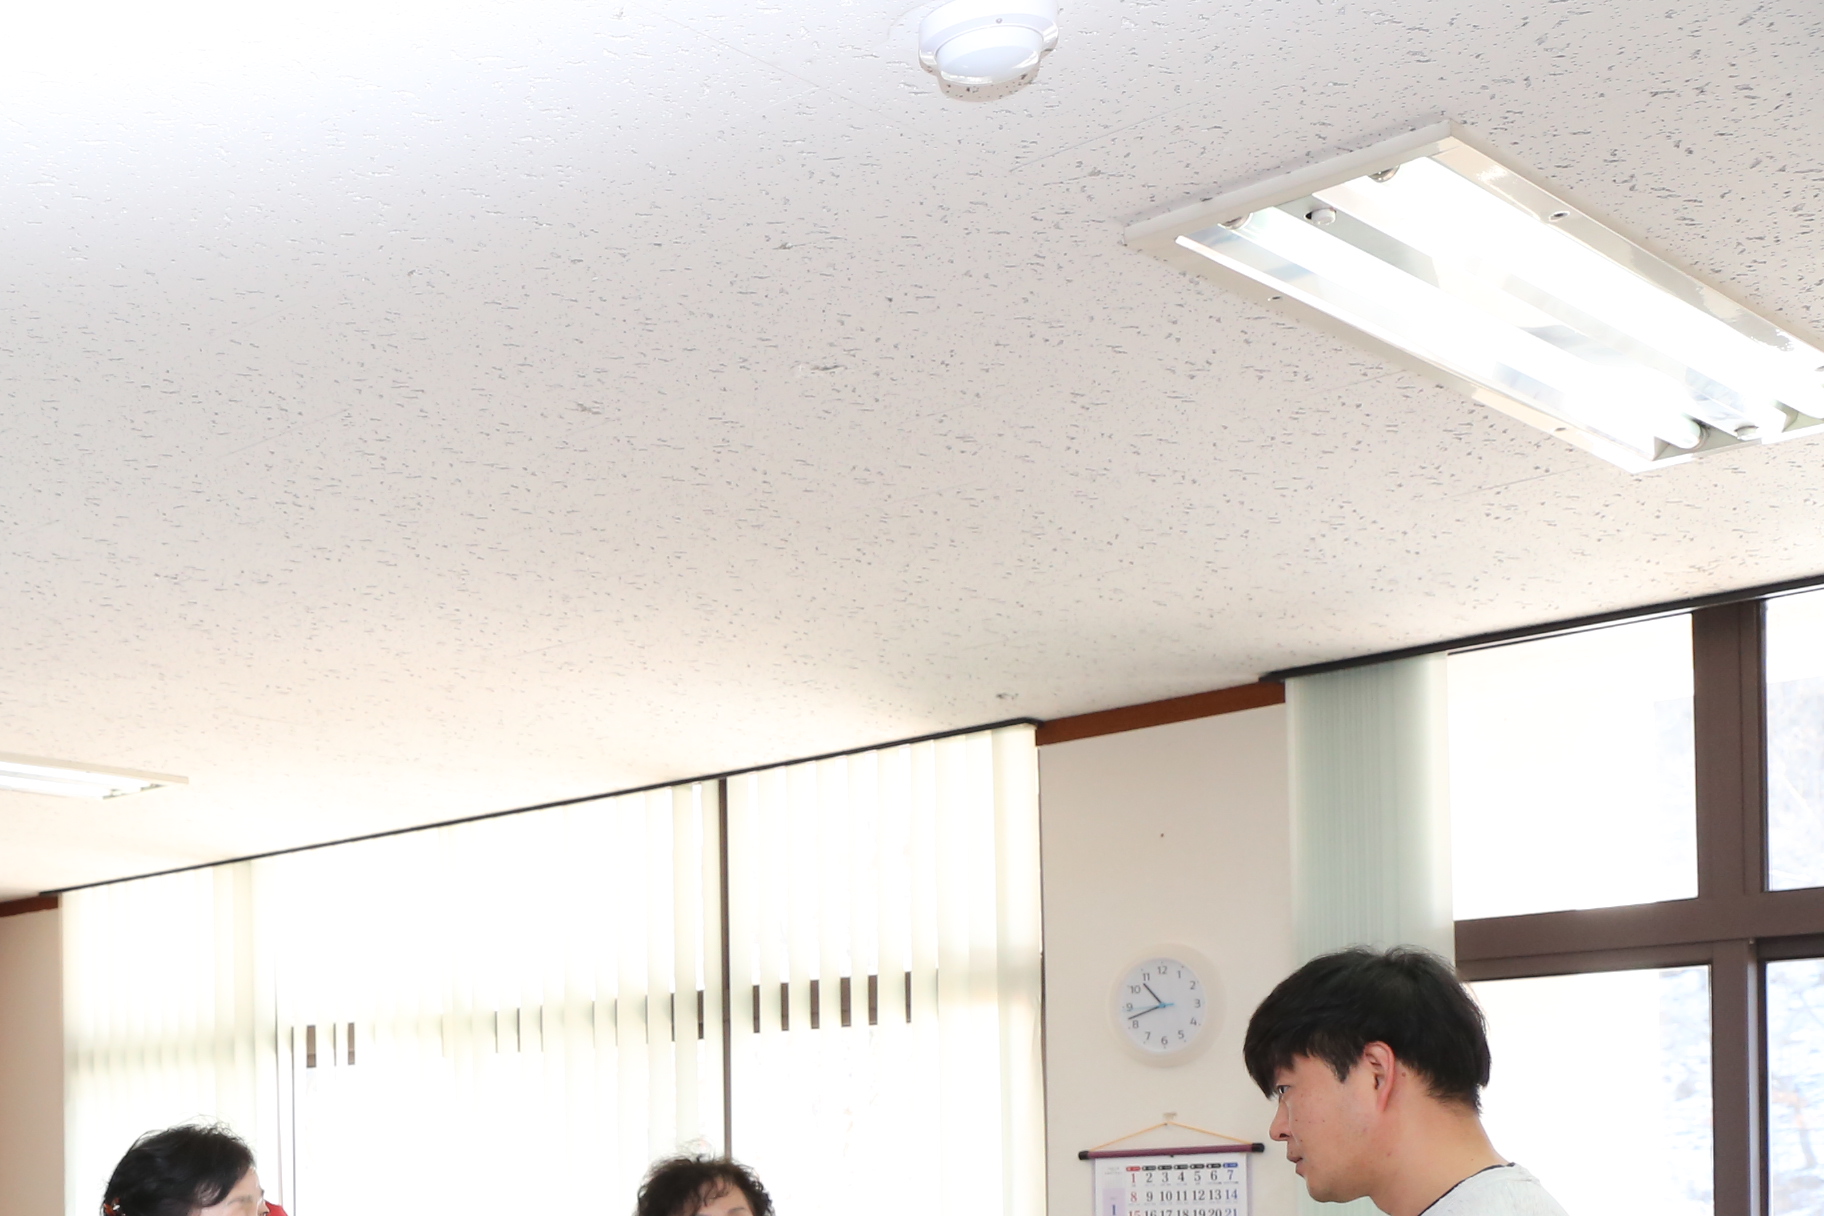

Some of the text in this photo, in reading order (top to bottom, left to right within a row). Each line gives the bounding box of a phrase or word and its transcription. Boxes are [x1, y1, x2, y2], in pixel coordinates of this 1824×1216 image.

[1160, 1191, 1173, 1201] 10
[1176, 1190, 1187, 1201] 11
[1192, 1190, 1205, 1200] 12
[1209, 1190, 1222, 1200] 13
[1225, 1189, 1238, 1200] 14
